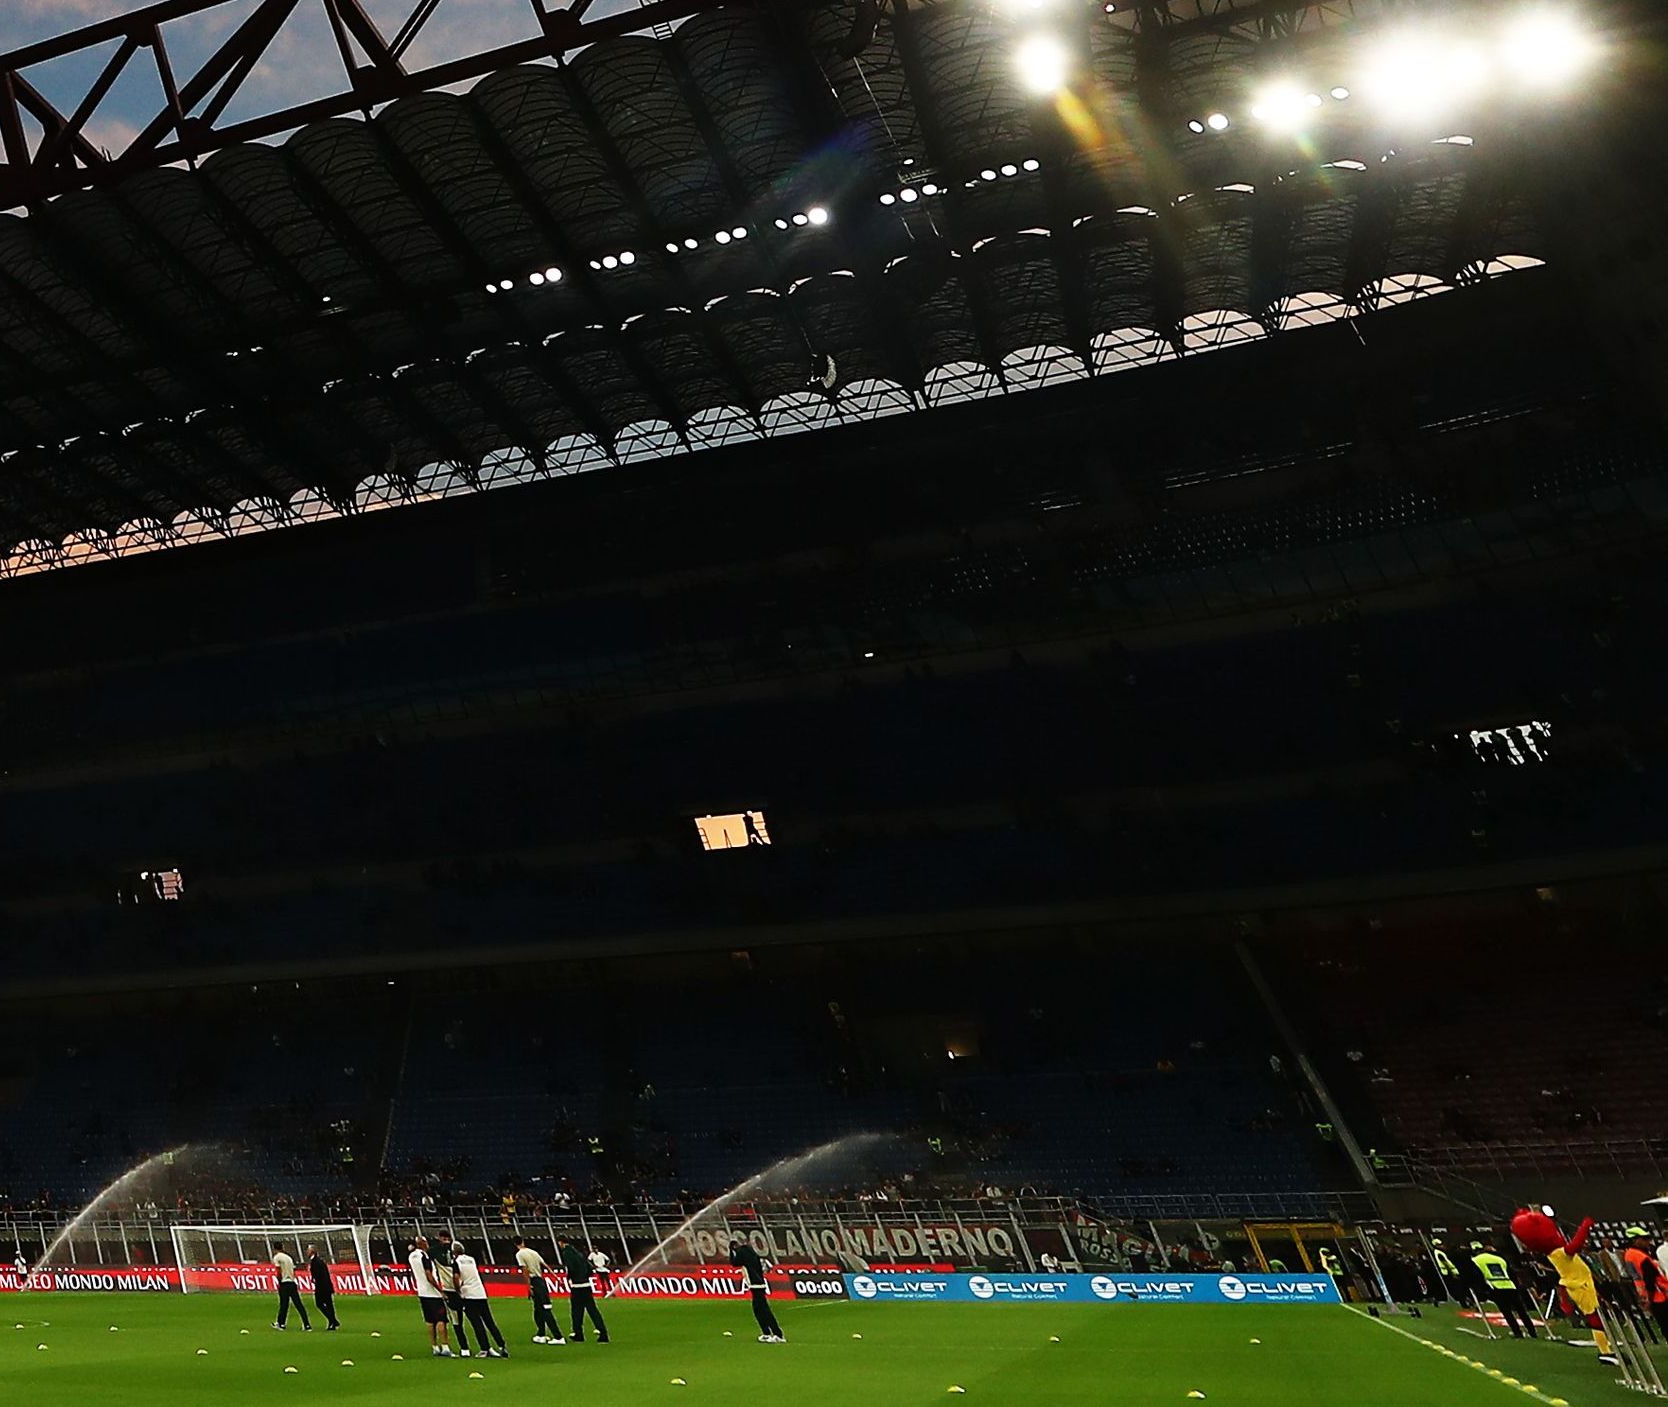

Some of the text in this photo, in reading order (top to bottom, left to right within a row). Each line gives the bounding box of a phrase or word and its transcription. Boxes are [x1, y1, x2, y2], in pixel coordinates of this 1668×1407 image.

[843, 1226, 1016, 1256] MADERNO
[55, 1274, 114, 1291] MONDO
[117, 1274, 170, 1291] MILAN
[230, 1275, 268, 1291] VISIT
[618, 1276, 697, 1295] MONDO
[795, 1281, 843, 1295] 00:00
